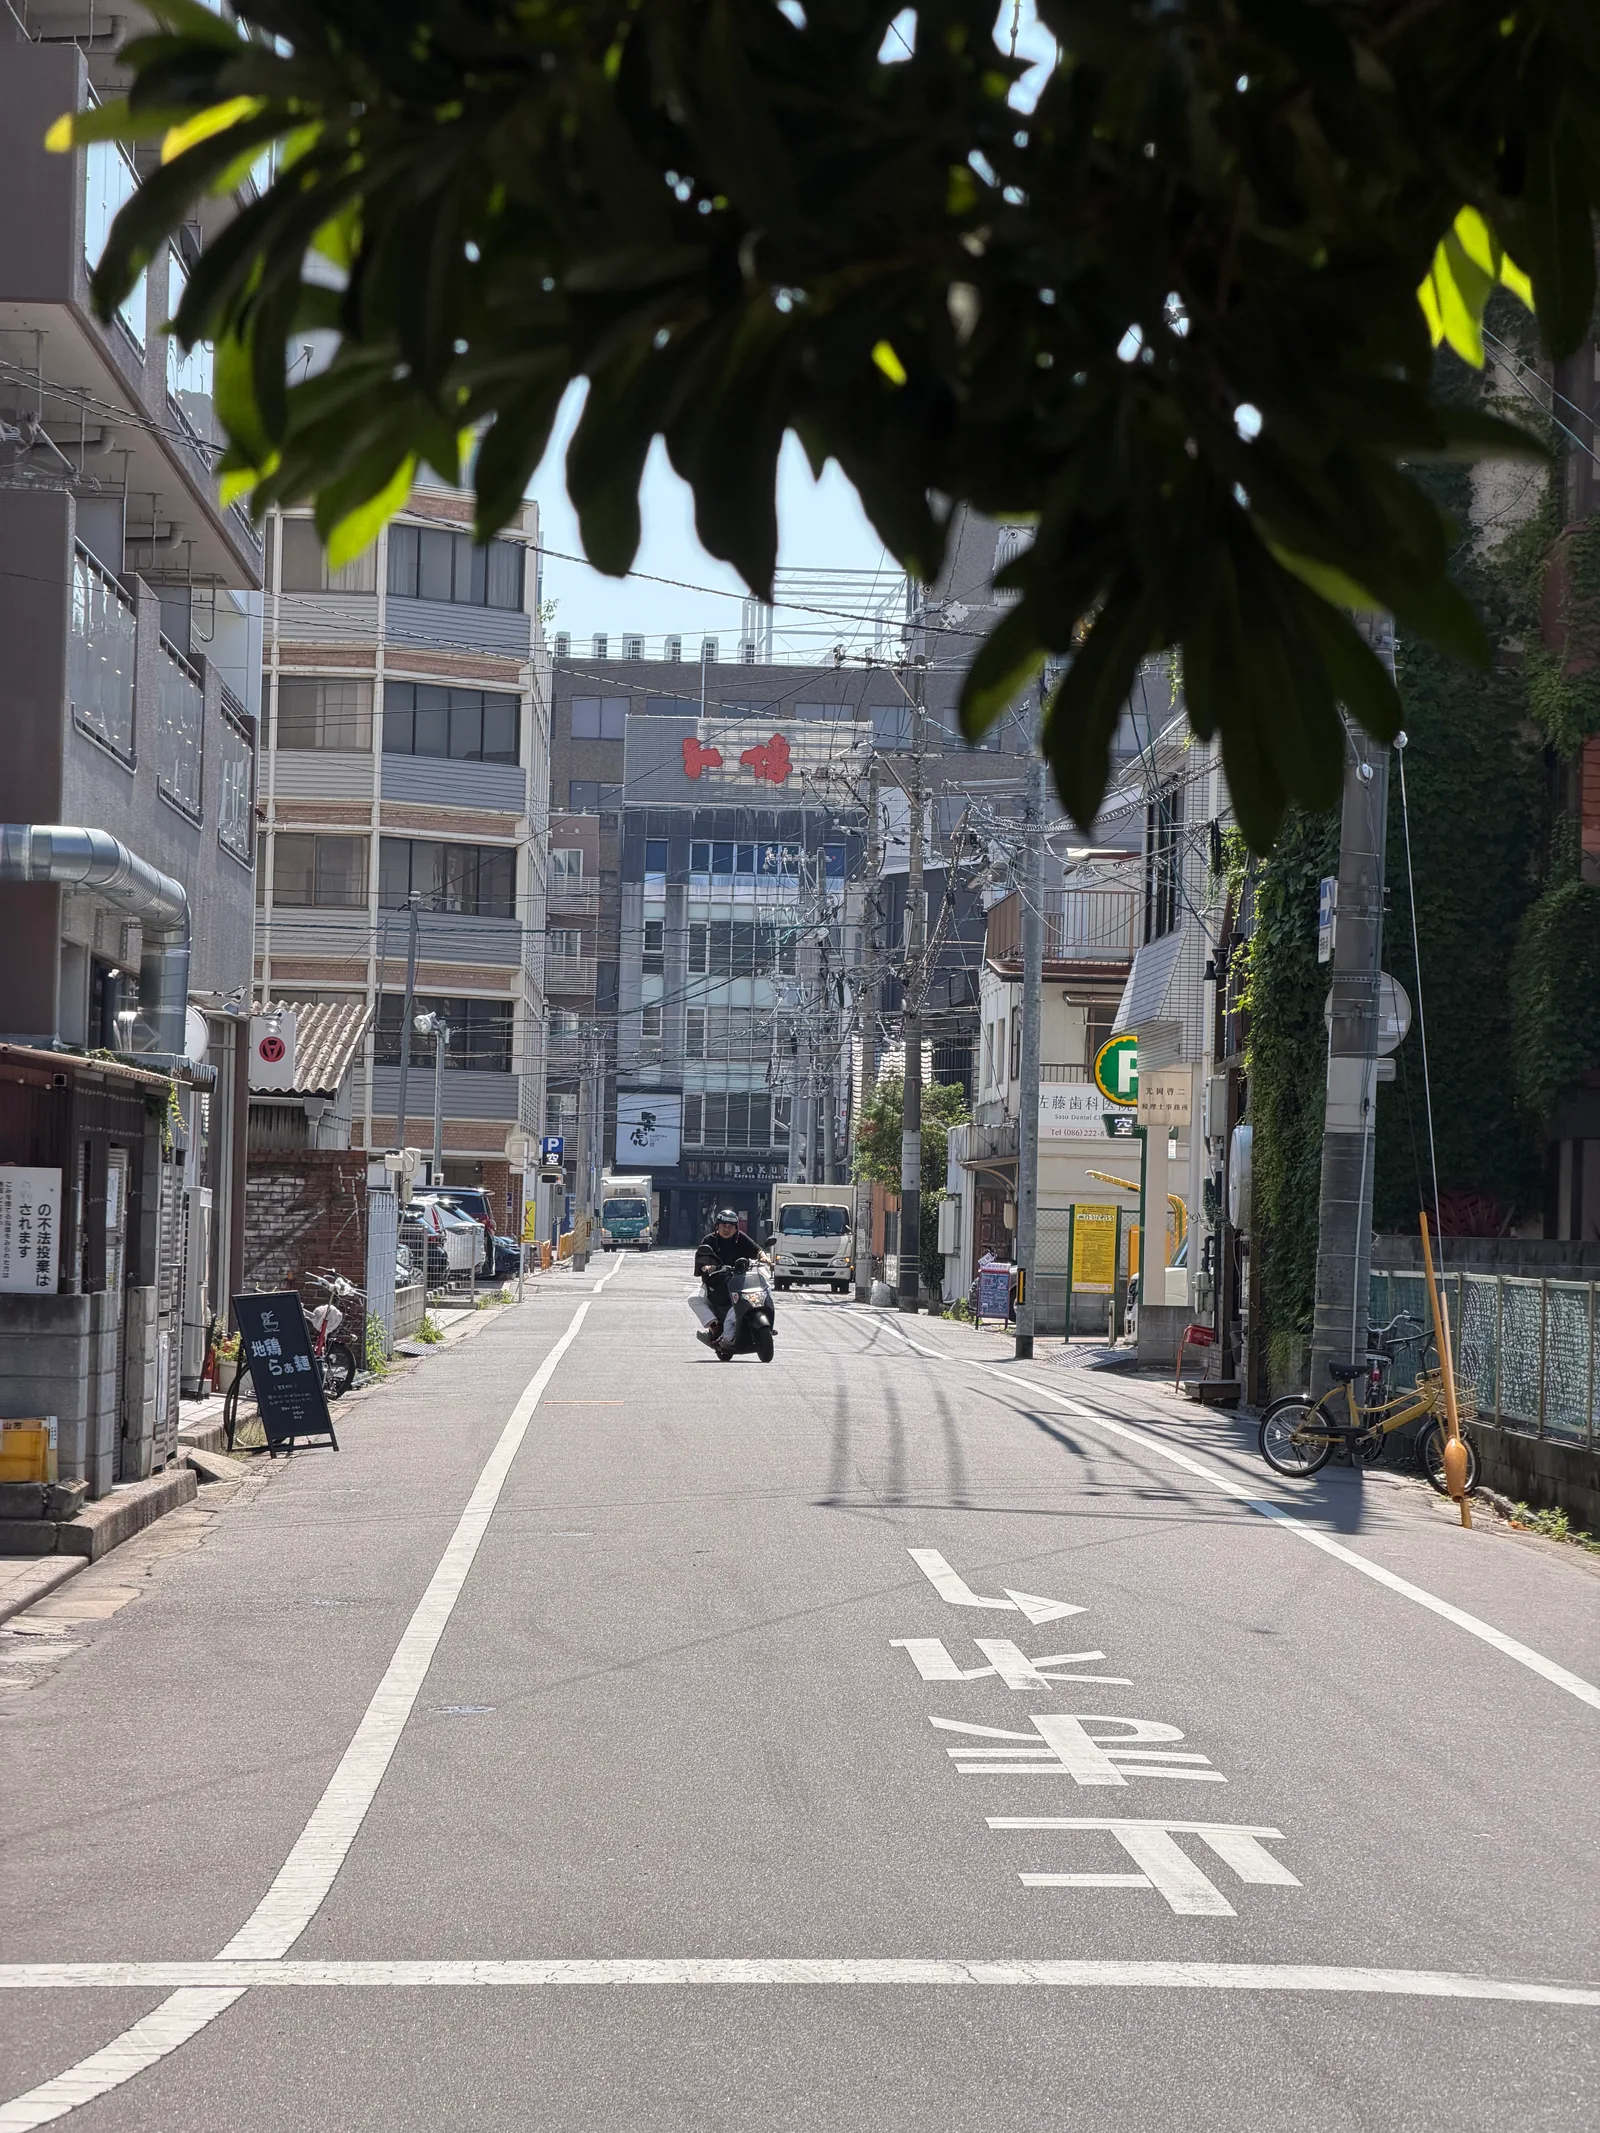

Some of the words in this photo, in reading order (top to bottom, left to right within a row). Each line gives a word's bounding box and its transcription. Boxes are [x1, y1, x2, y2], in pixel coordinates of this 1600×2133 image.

[1141, 1103, 1188, 1111] 税理士事務所
[1114, 1117, 1133, 1136] 空
[547, 1138, 560, 1151] P
[734, 1165, 790, 1174] BOKUD
[251, 1337, 282, 1357] 地鶏
